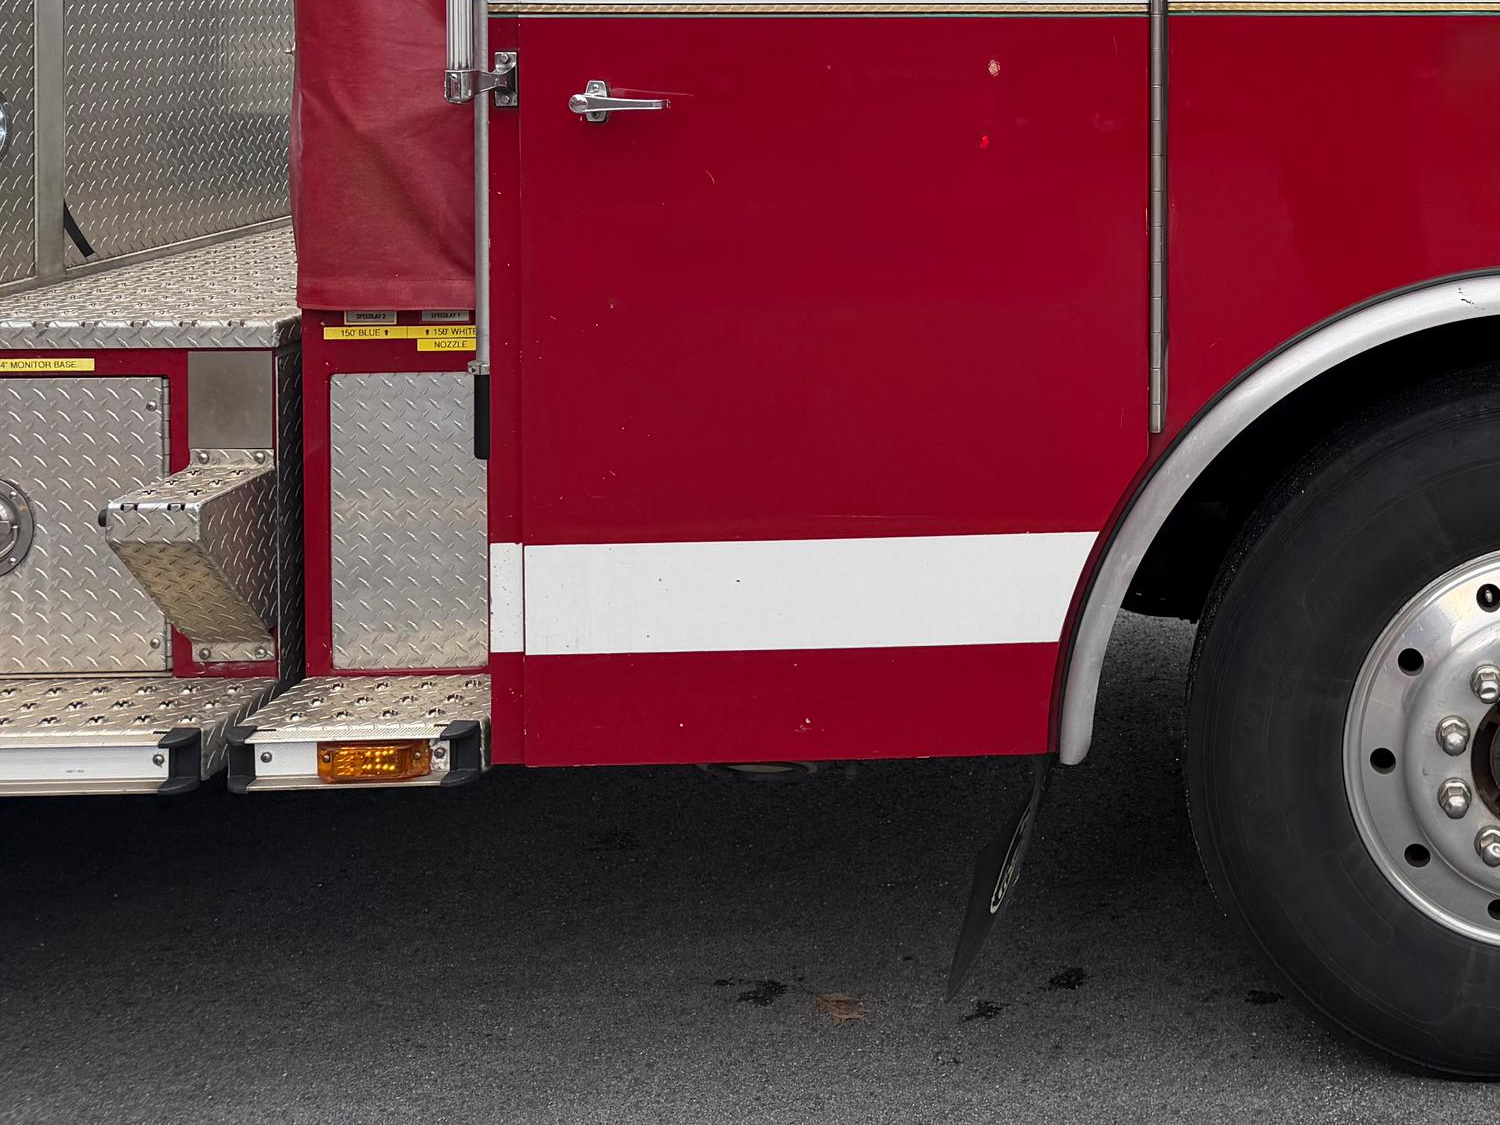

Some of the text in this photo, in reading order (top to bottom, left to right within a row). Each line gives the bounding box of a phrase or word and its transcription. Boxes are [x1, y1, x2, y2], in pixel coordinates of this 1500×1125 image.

[341, 328, 380, 337] 150' BLUE
[434, 328, 476, 336] 150' WHITE
[434, 340, 468, 349] NOZZLE
[10, 360, 52, 369] MONITOR
[53, 360, 78, 369] BASE
